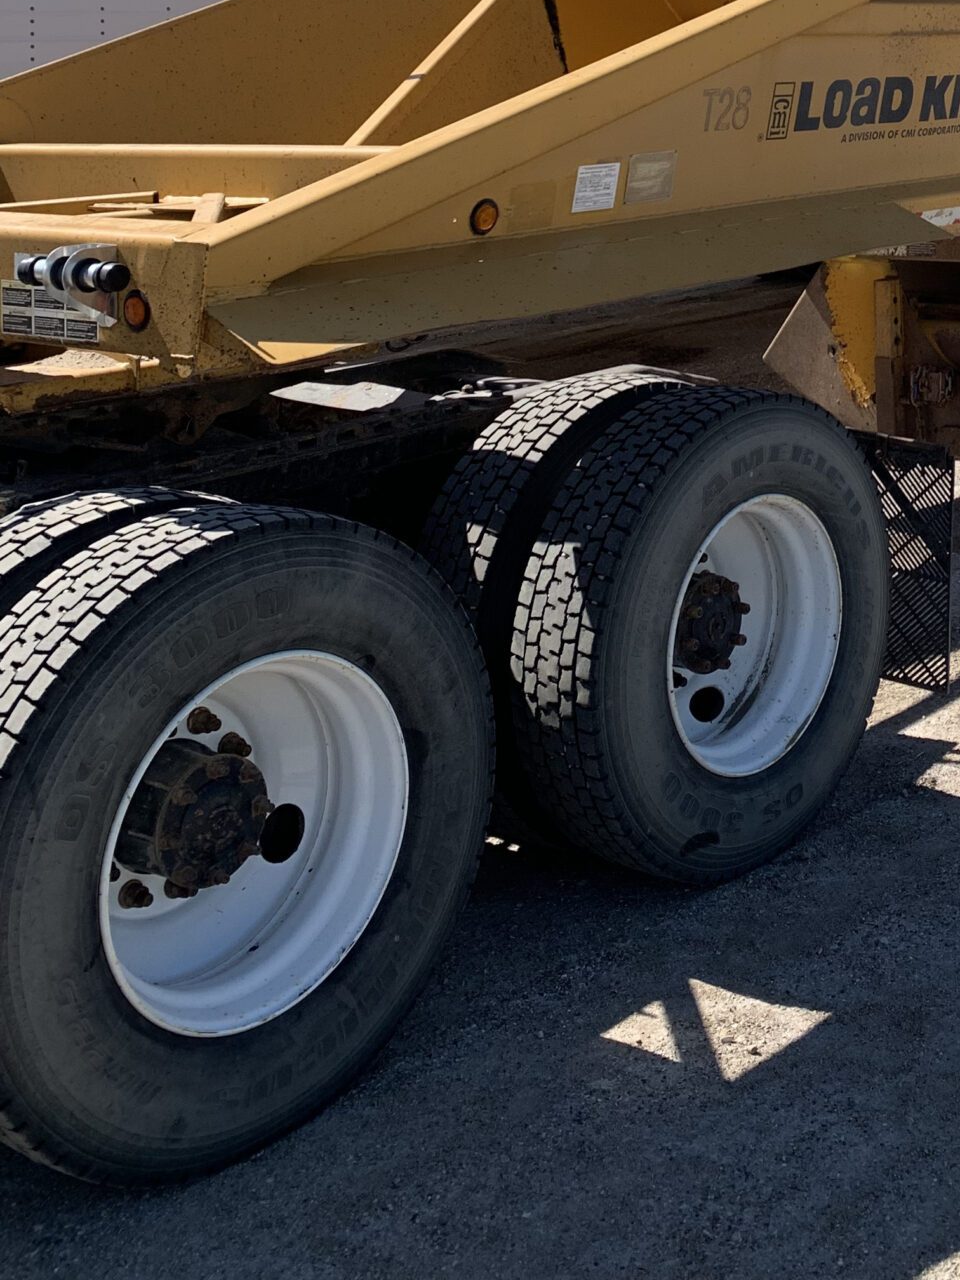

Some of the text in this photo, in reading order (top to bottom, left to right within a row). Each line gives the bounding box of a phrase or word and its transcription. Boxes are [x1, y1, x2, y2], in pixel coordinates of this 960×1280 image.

[703, 86, 752, 133] T28
[848, 131, 886, 142] DIVISION
[887, 130, 899, 139] OF
[702, 442, 871, 549] AMERICUS
[128, 586, 293, 710] 3000
